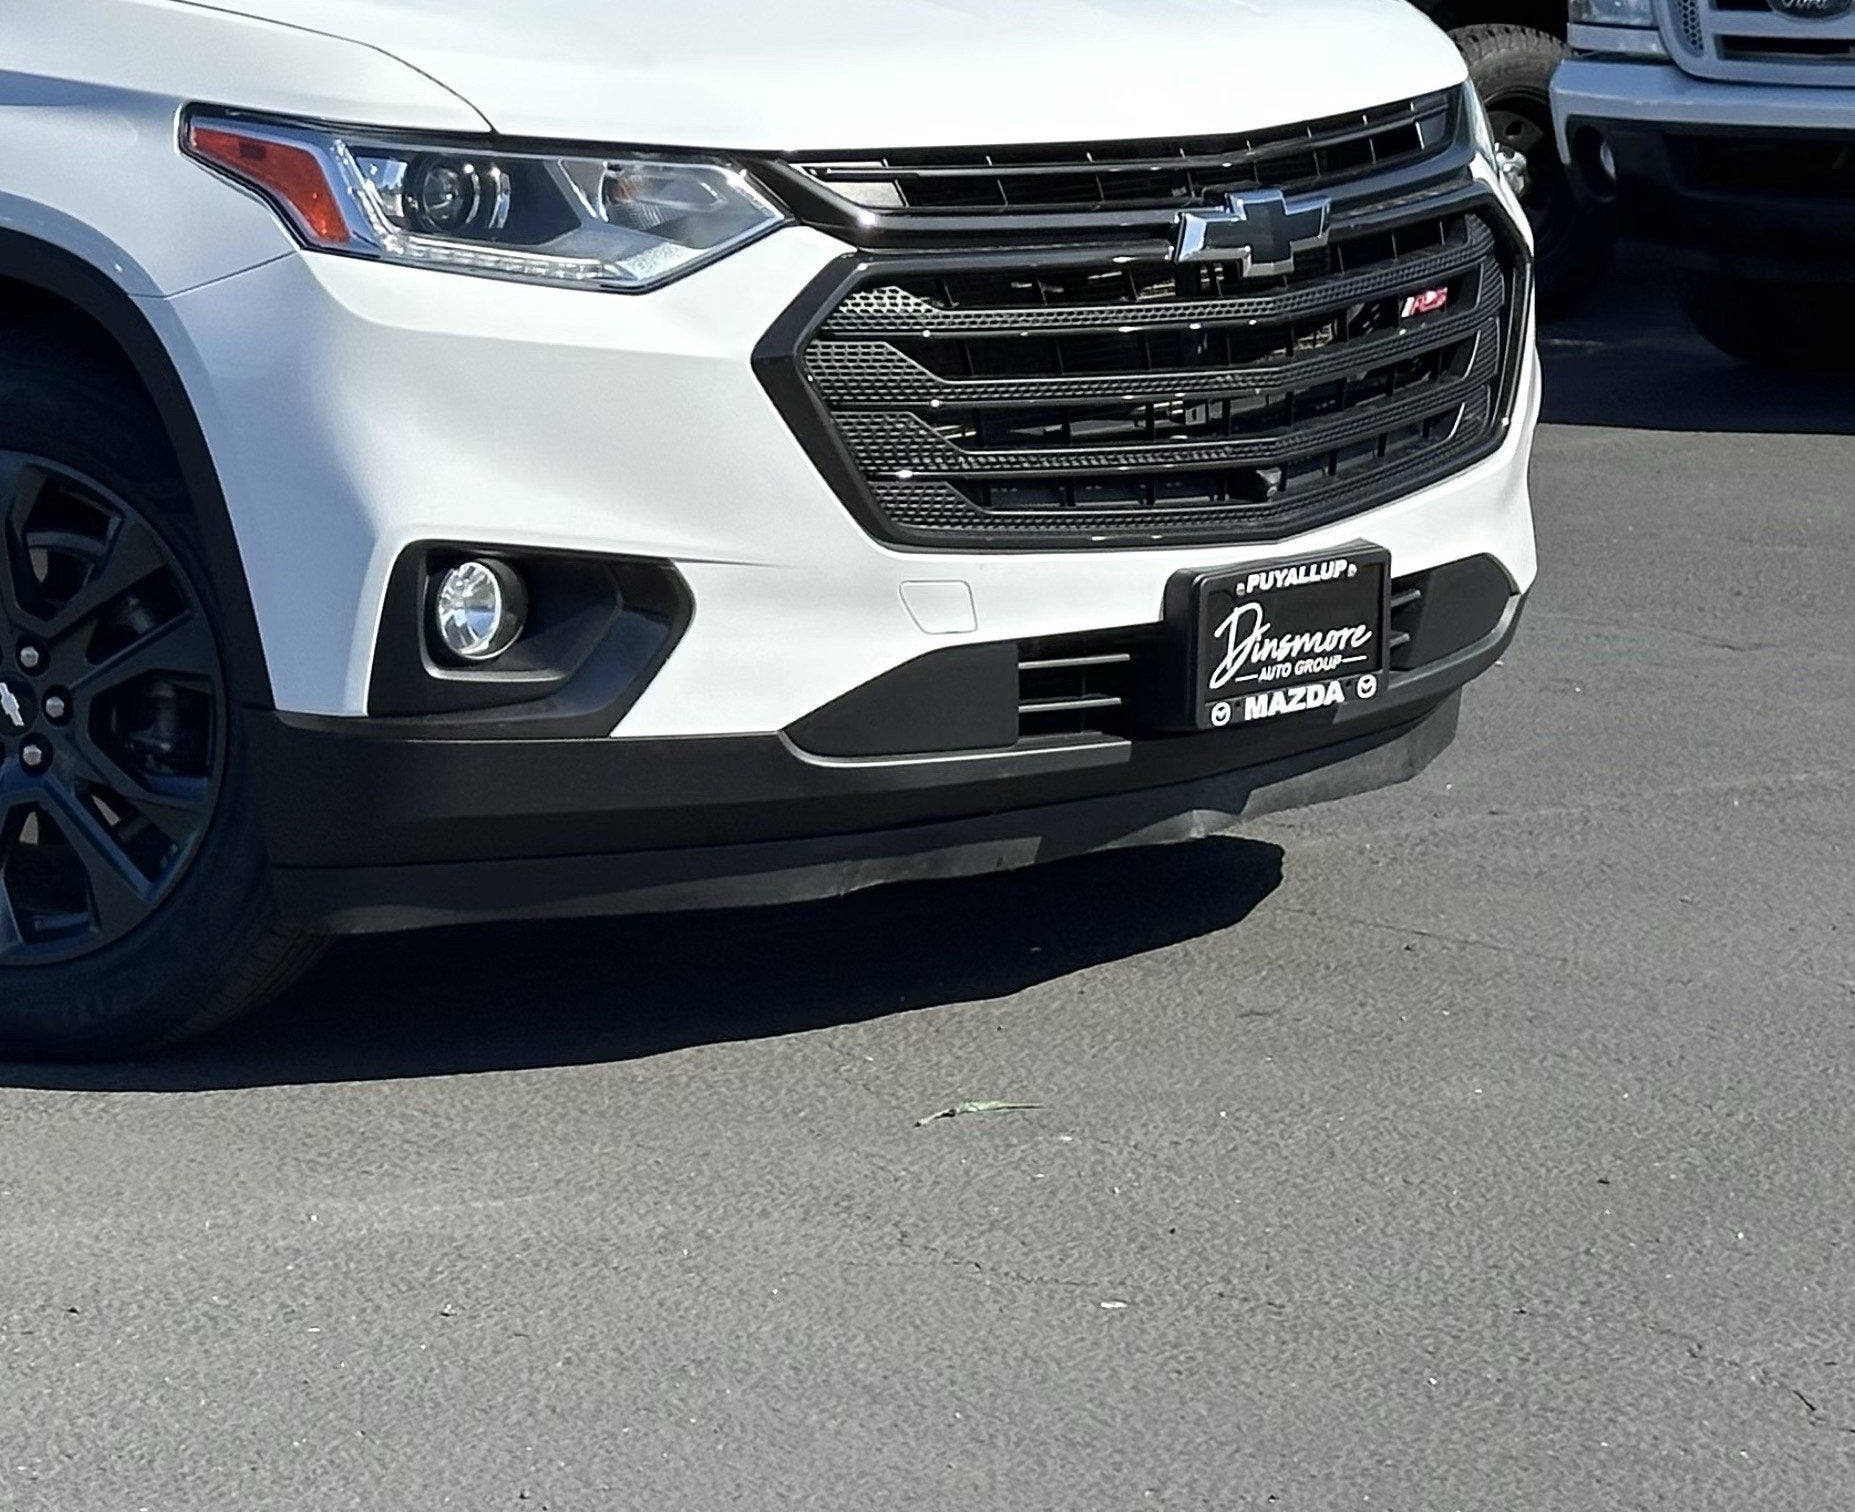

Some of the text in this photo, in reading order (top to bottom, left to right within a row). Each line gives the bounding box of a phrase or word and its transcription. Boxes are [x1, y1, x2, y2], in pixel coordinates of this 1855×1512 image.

[1246, 559, 1348, 593] PUYALLUP
[1209, 601, 1373, 689] Dinsmore
[1258, 655, 1343, 682] AUTO GROUP
[1244, 680, 1346, 721] MAZDA
